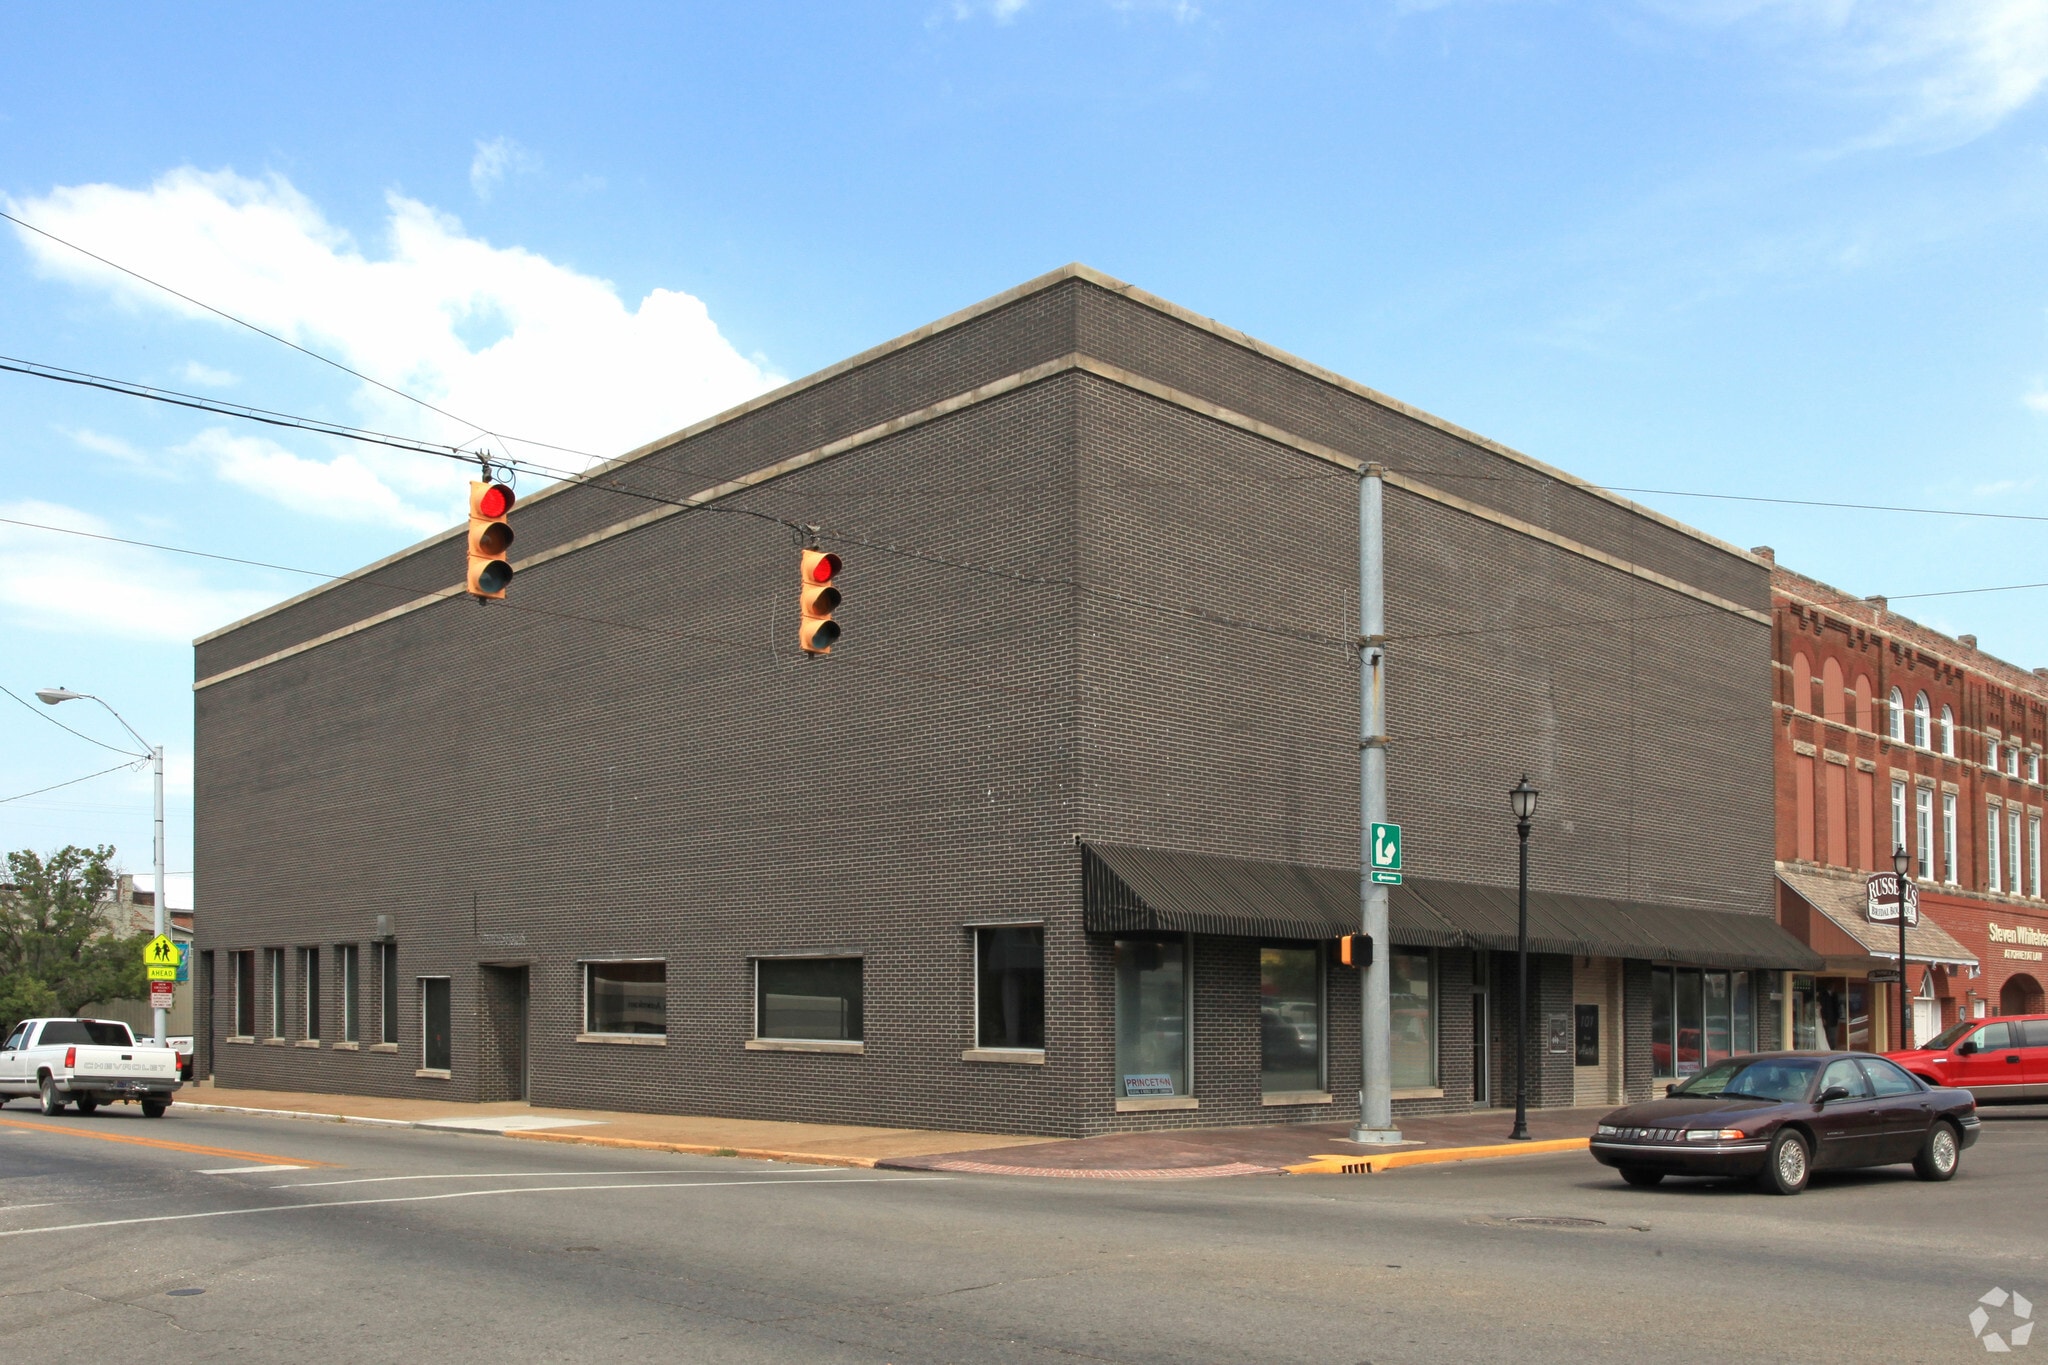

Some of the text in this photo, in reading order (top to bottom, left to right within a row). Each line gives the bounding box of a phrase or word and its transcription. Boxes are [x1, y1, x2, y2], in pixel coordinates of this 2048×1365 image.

[1868, 877, 1917, 907] RUSSEL'S
[1871, 906, 1914, 917] BRIDAL BOUQUE
[1989, 922, 2017, 943] Steven
[1580, 1015, 1594, 1027] 101
[84, 1062, 166, 1071] CHEVROLET
[1126, 1078, 1171, 1087] PRINCETON
